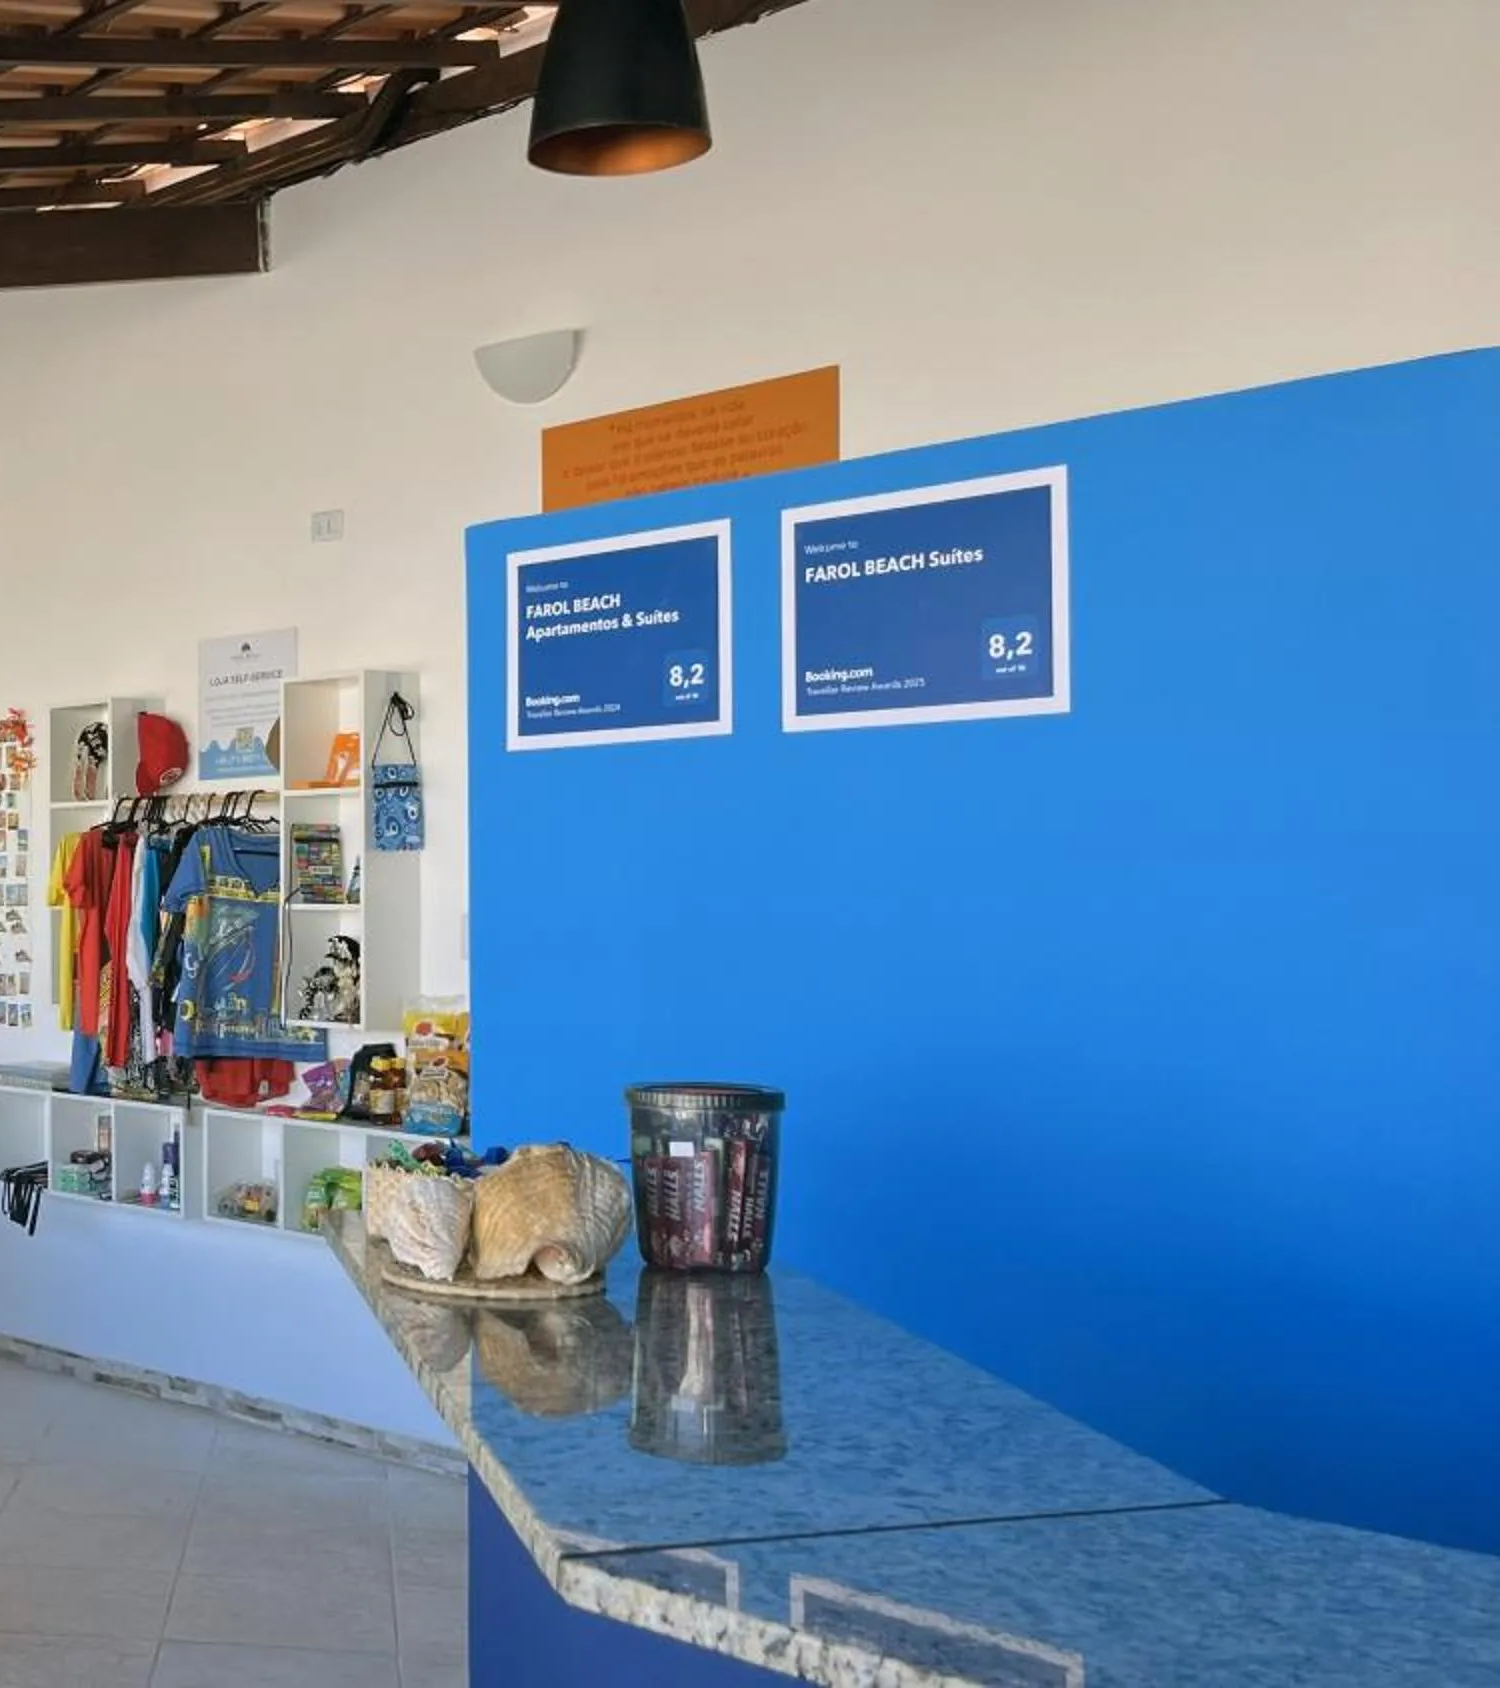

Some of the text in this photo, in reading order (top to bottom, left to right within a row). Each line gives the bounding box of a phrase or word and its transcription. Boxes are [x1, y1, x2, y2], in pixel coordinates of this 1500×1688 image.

[805, 563, 860, 583] FAROL
[865, 553, 924, 576] BEACH
[526, 593, 621, 619] FAROL BEACH
[526, 618, 619, 642] Apartamentos
[621, 613, 633, 628] &
[988, 631, 1033, 661] 8,2
[669, 663, 704, 689] 8,2
[805, 667, 873, 683] Booking.com
[525, 693, 581, 708] Booking.com
[662, 1167, 681, 1221] HALLS
[693, 1159, 706, 1213] HALLS
